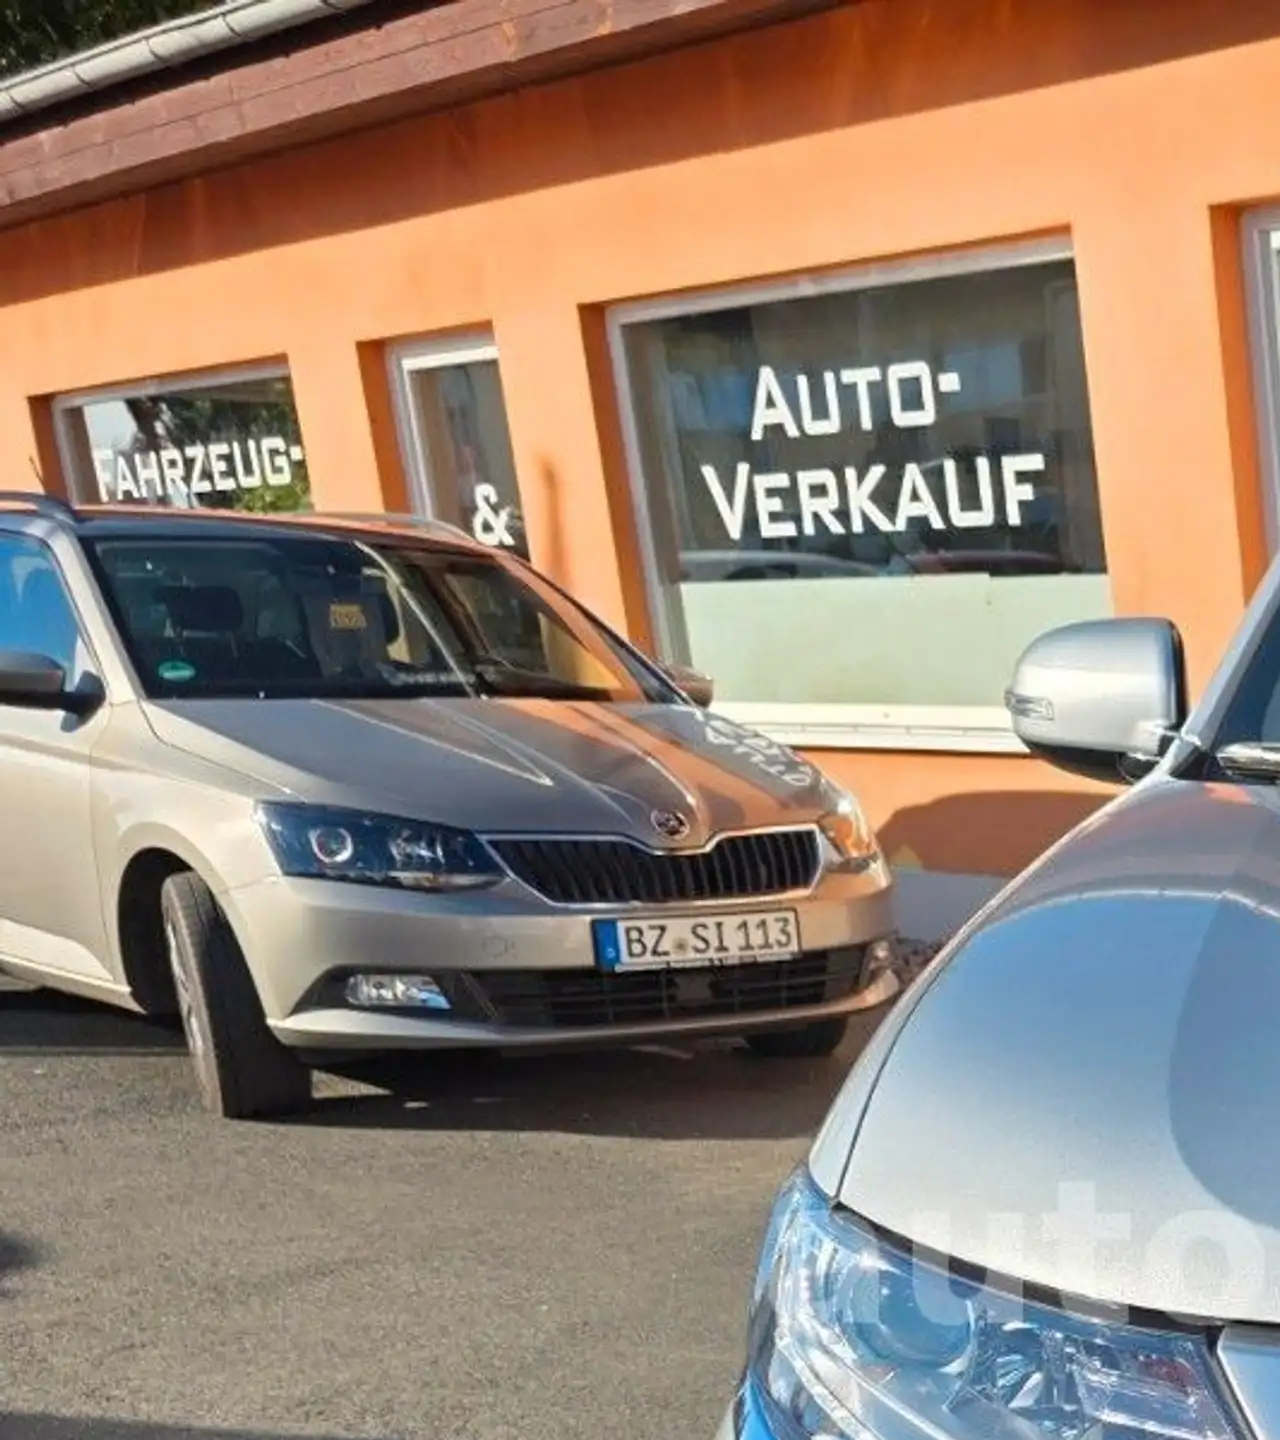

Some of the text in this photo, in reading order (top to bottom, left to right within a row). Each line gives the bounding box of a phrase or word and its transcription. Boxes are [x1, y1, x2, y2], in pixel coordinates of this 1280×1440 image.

[750, 359, 962, 442] AUTO-
[92, 435, 306, 501] FAHRZEUG-
[701, 451, 1046, 541] VERKAUF
[472, 483, 515, 547] &
[624, 916, 793, 958] BZ SI 113
